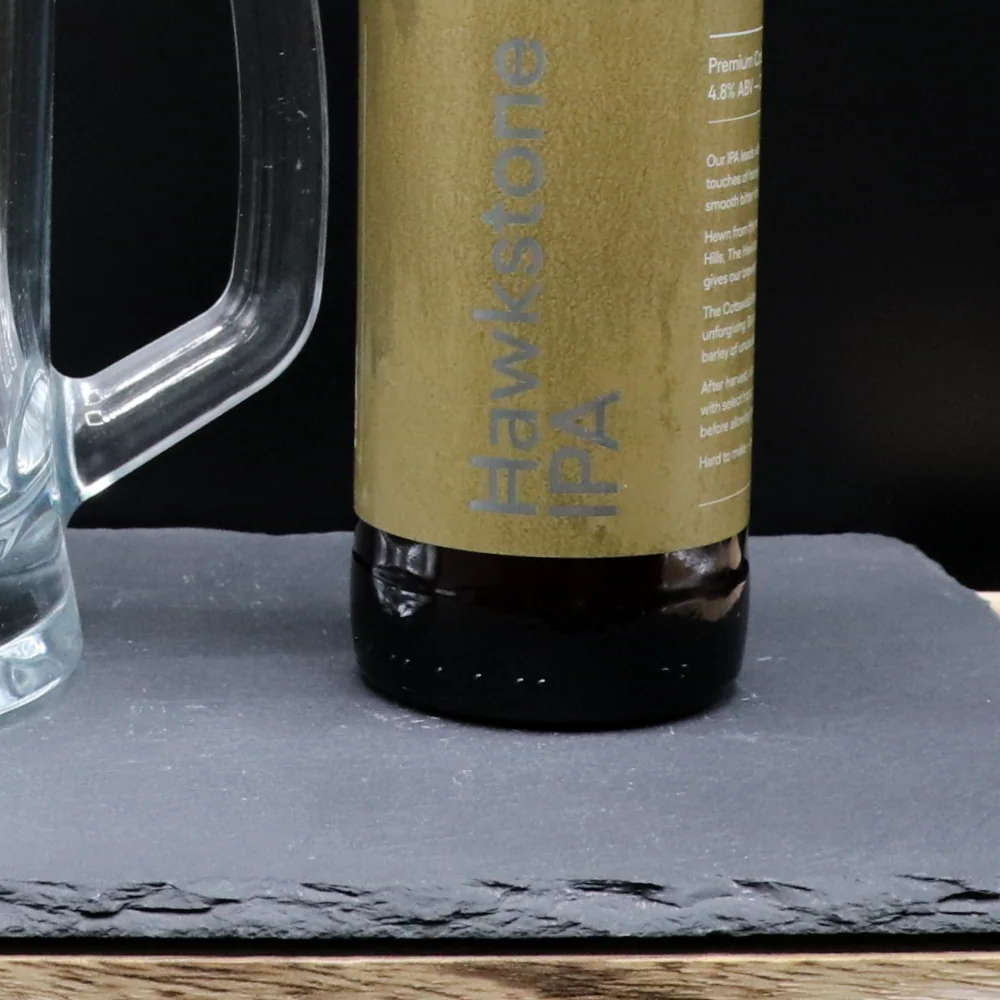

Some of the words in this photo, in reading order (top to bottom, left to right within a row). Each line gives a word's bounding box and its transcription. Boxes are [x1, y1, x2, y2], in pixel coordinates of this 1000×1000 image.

[708, 53, 753, 74] Premium
[707, 83, 736, 101] 4.8%
[737, 78, 754, 97] ABV
[706, 153, 726, 168] Our
[727, 150, 740, 165] IPA
[705, 174, 741, 190] touches
[704, 194, 739, 212] smooth
[704, 229, 731, 244] Hewn
[470, 34, 549, 516] Hawkstone
[703, 272, 728, 291] gives
[703, 305, 721, 319] The
[700, 379, 724, 394] After
[548, 389, 621, 517] IPA
[699, 451, 721, 469] Hard
